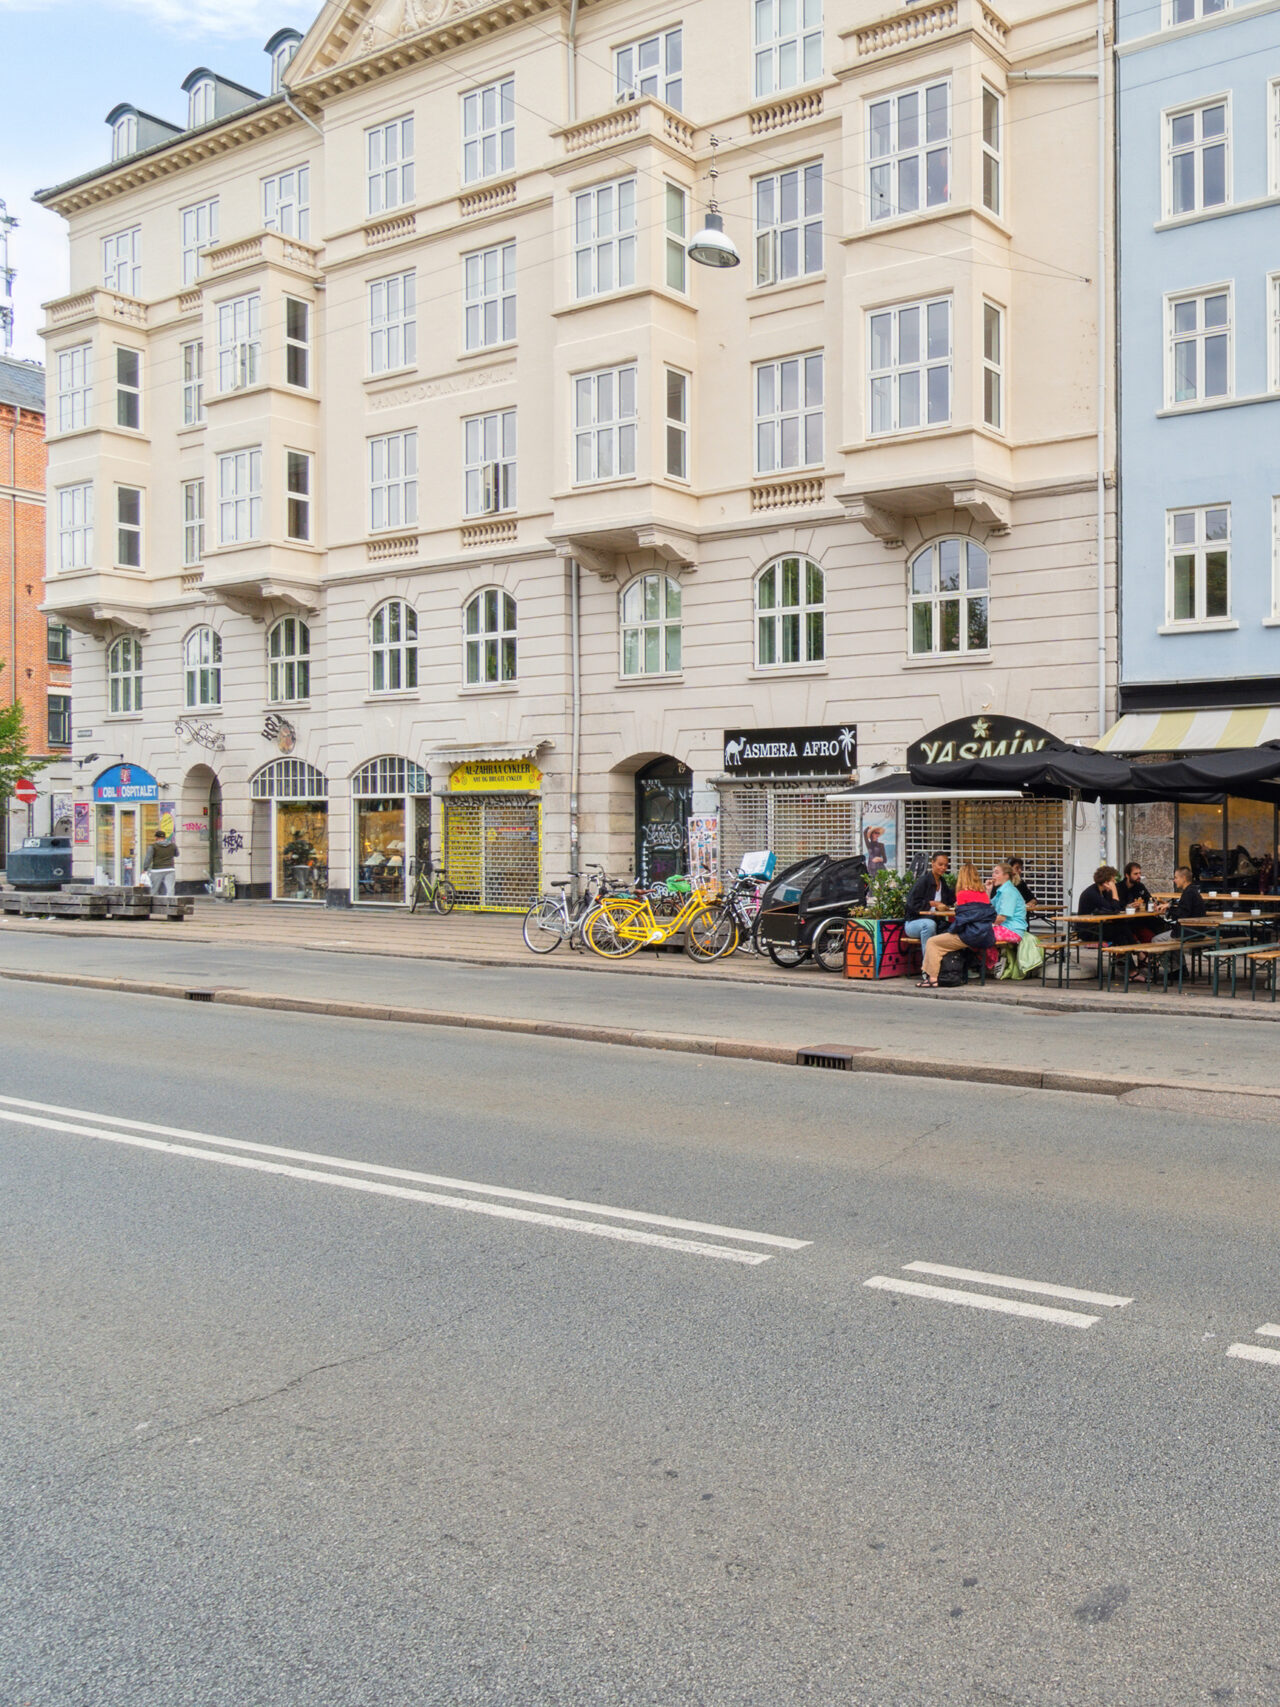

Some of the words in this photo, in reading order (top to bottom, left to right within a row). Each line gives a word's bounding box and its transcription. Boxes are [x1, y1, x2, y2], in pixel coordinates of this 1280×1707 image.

[743, 742, 797, 758] ASMERA
[803, 740, 839, 757] AFRO
[503, 763, 531, 774] CYKLER
